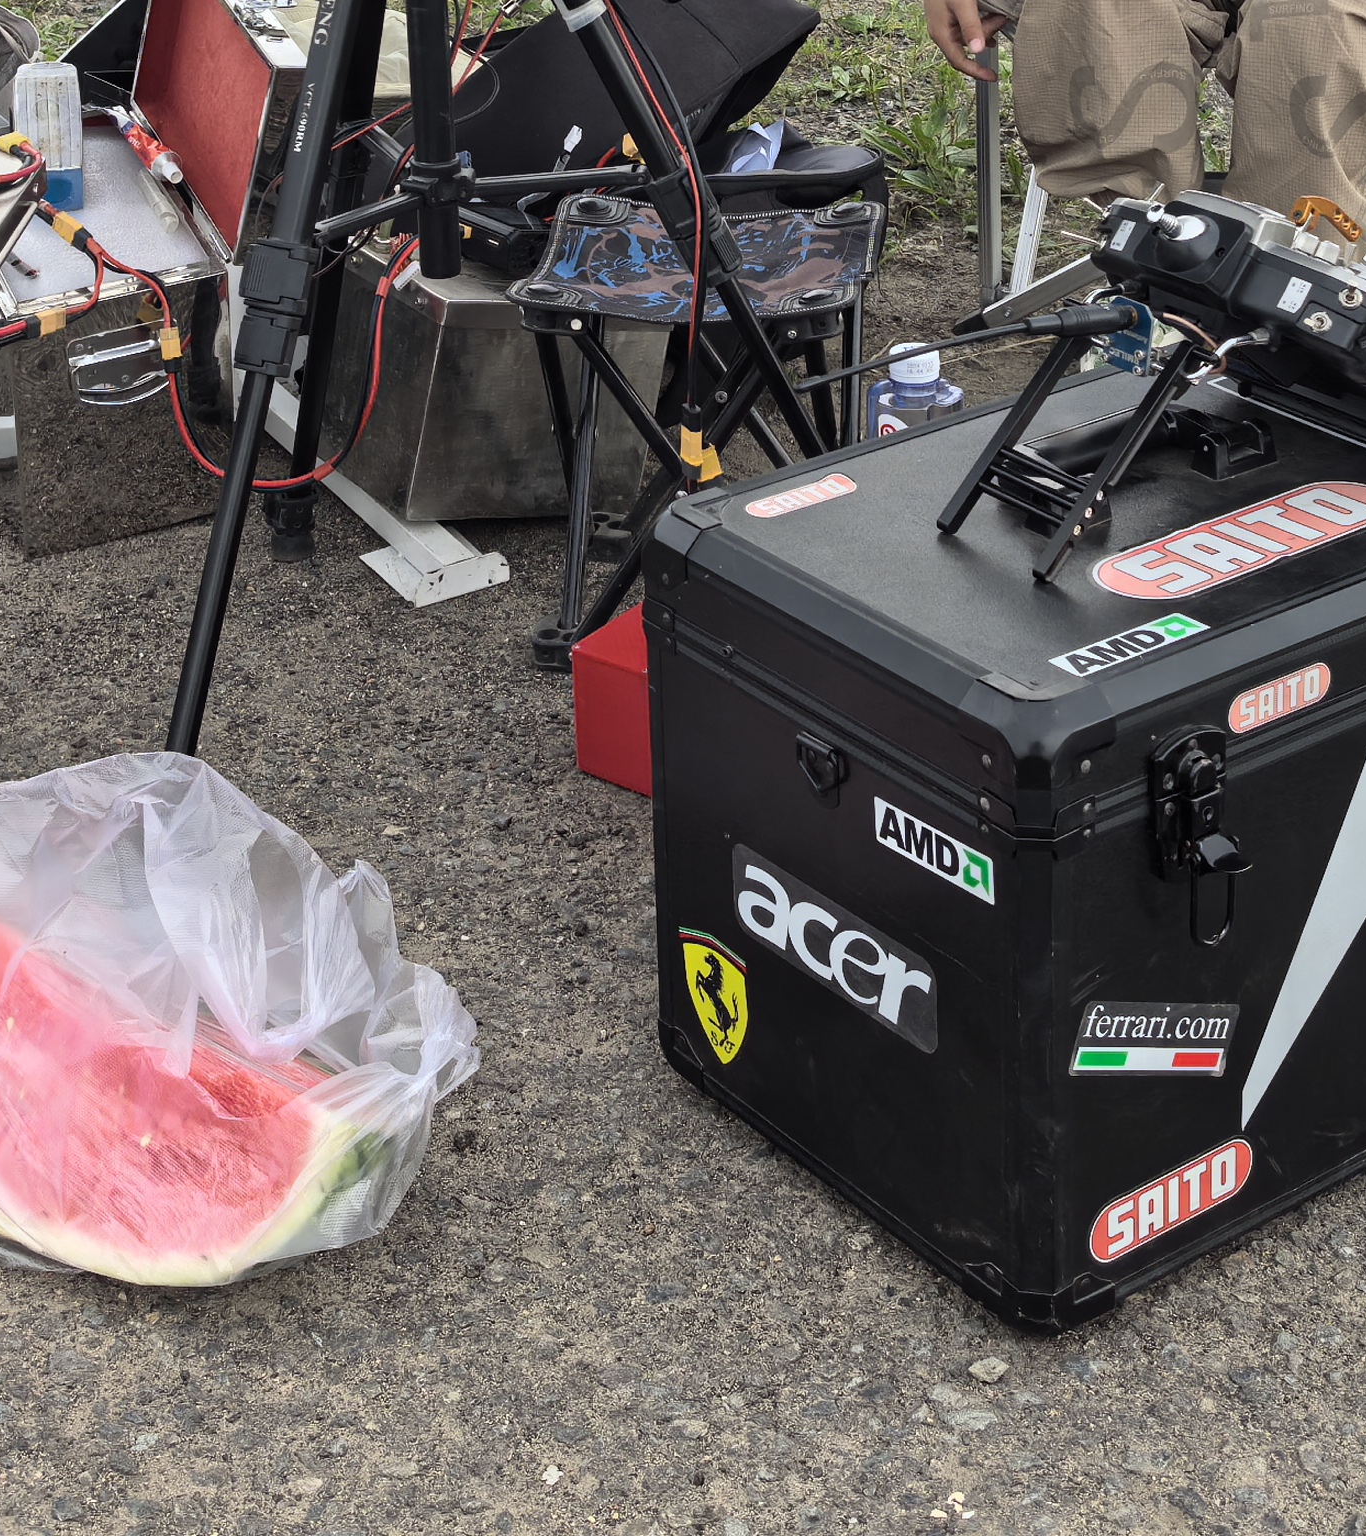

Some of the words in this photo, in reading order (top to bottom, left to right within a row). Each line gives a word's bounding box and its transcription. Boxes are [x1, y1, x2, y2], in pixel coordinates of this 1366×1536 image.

[1268, 3, 1314, 14] SURFING
[760, 478, 848, 516] SAITO
[1068, 627, 1167, 675] AMD
[1240, 668, 1320, 727] SAITO
[879, 806, 960, 877] AMD
[737, 864, 932, 1025] acer
[1082, 1004, 1230, 1040] ferrari.com
[1107, 1146, 1237, 1256] SAITO
